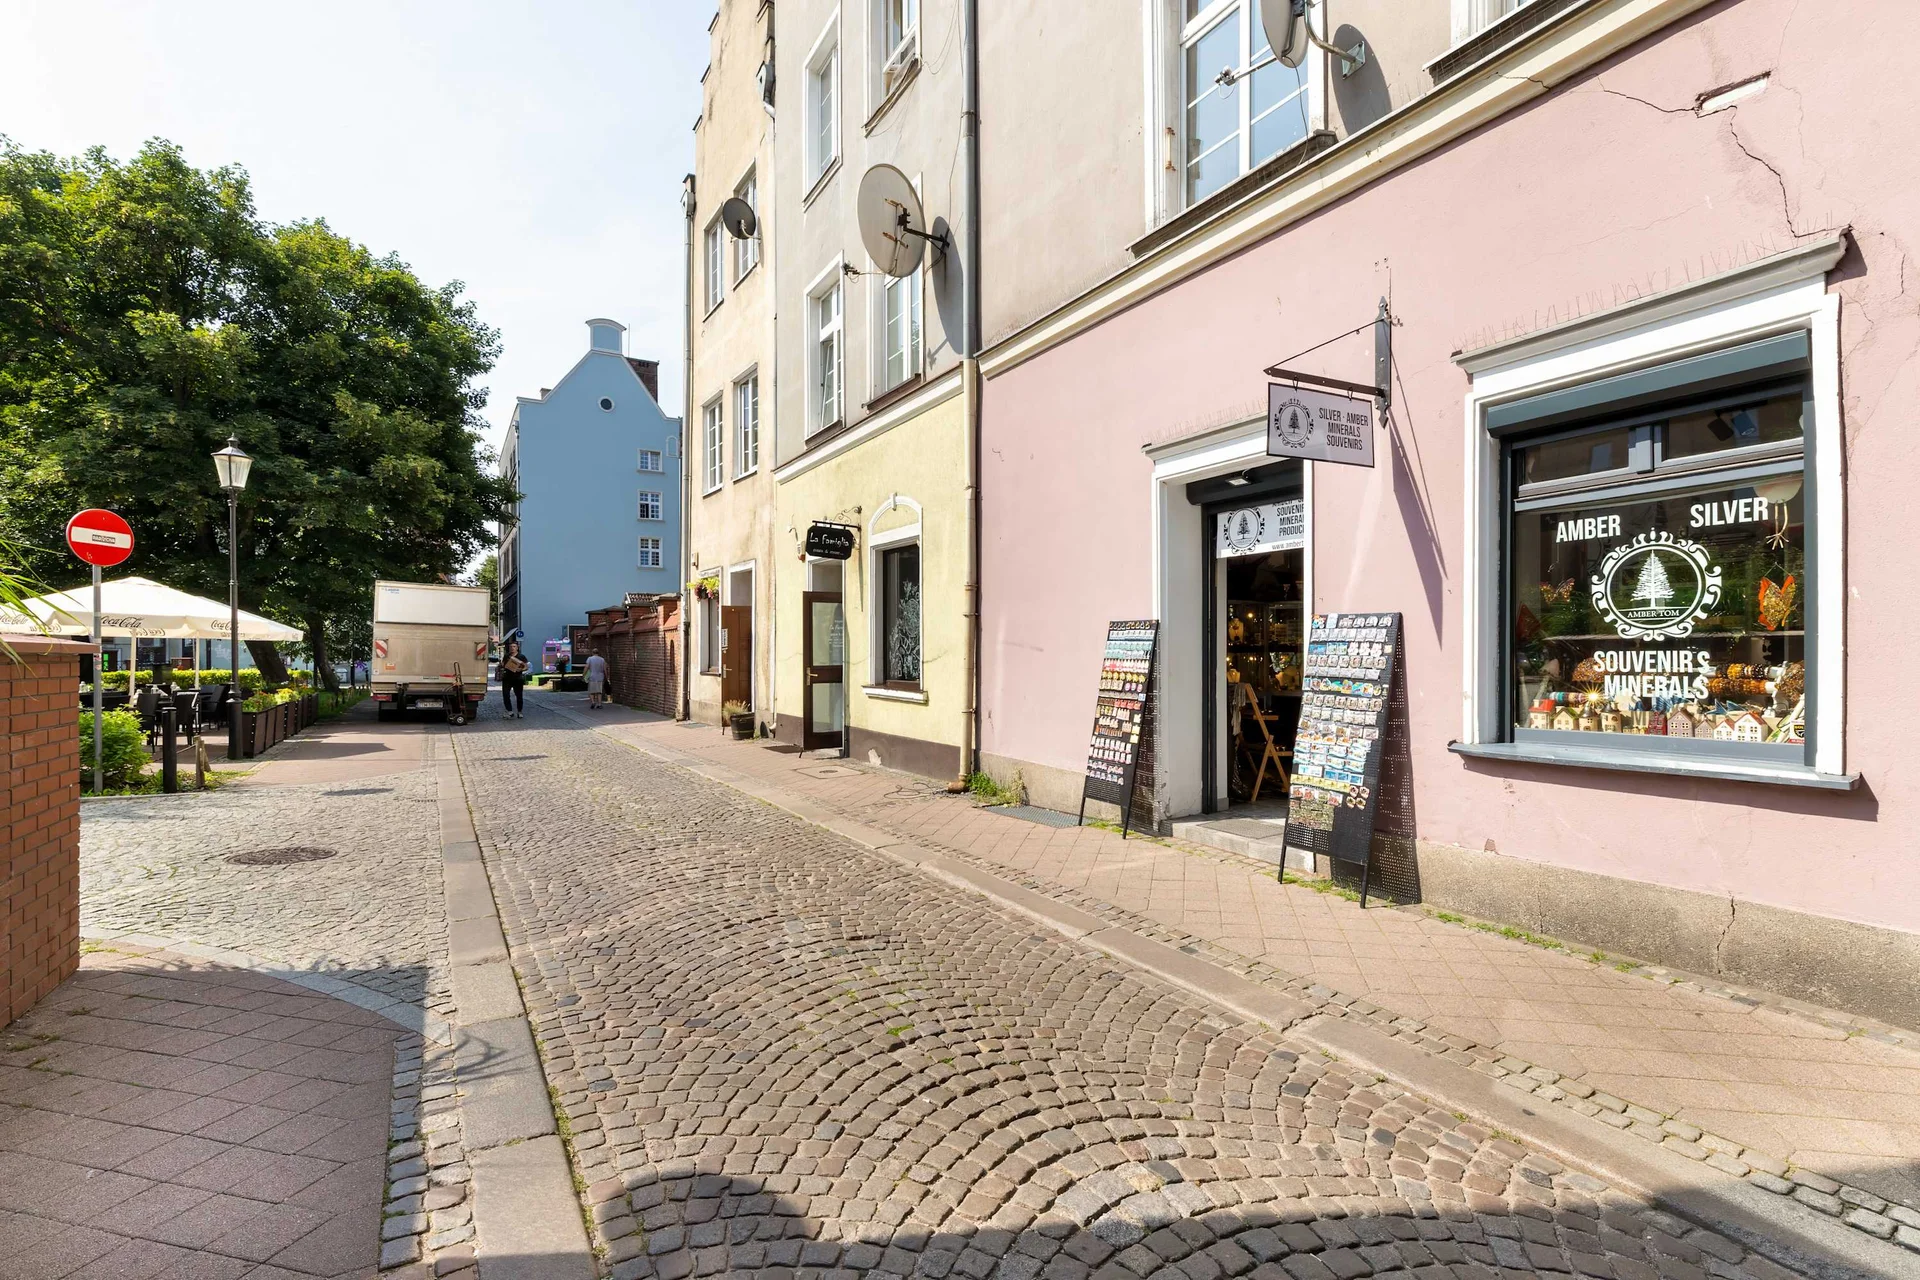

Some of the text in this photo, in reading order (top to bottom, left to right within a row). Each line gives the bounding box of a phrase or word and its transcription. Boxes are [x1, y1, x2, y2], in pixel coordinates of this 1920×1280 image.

[1319, 408, 1368, 426] SILVER AMBER
[1328, 422, 1361, 437] MINERALS
[1326, 435, 1363, 450] SOUVENIRS
[1279, 513, 1304, 526] MINERA
[1690, 496, 1769, 528] SILVER
[1278, 524, 1304, 537] PRODUC
[1555, 514, 1621, 543] AMBER
[1627, 609, 1680, 618] AMBER TOM
[1593, 649, 1711, 673] SOUVENIRS
[1603, 674, 1709, 700] MINERALS
